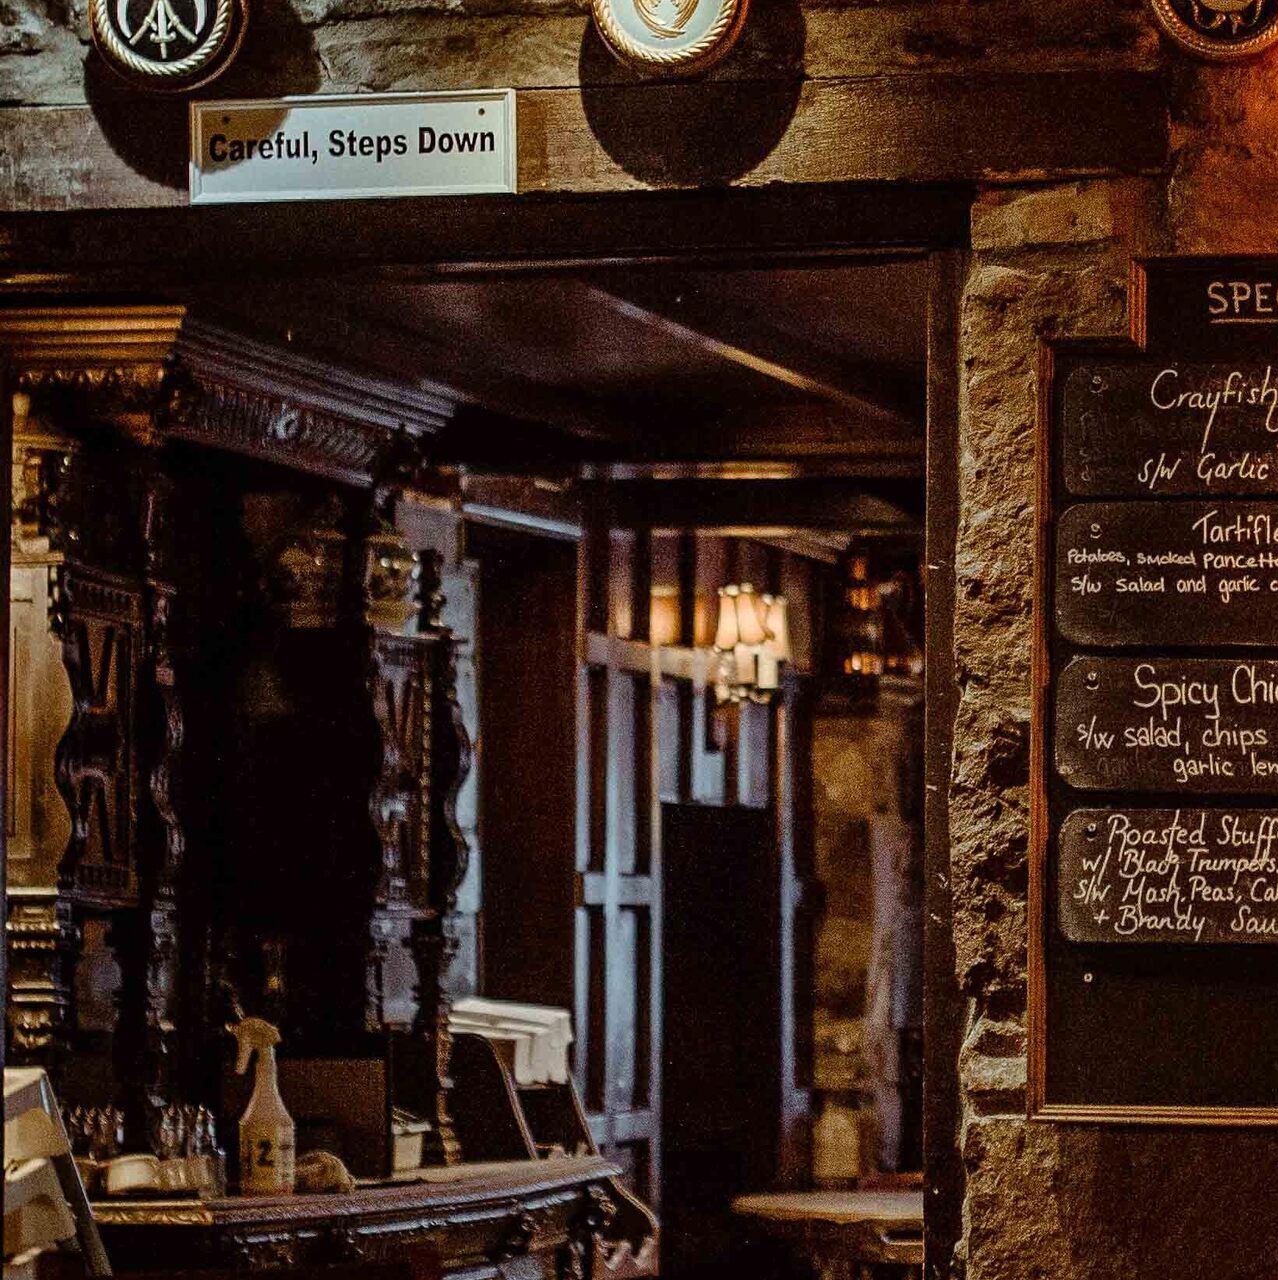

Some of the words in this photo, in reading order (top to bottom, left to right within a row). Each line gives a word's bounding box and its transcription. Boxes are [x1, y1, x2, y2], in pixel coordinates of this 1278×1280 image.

[208, 131, 318, 165] Careful,
[328, 129, 408, 163] Steps
[418, 126, 496, 154] Down
[1151, 365, 1278, 454] Crayfish
[1197, 453, 1269, 486] Garlic
[1176, 575, 1207, 593] and
[1218, 575, 1260, 603] garlic
[1133, 664, 1221, 721] Spicy
[1124, 716, 1190, 755] salad,
[1202, 720, 1269, 755] chips
[1173, 753, 1234, 783] garlic
[1108, 809, 1206, 862] Roasted
[1189, 876, 1242, 903] Peas,
[1114, 904, 1206, 941] Brandy
